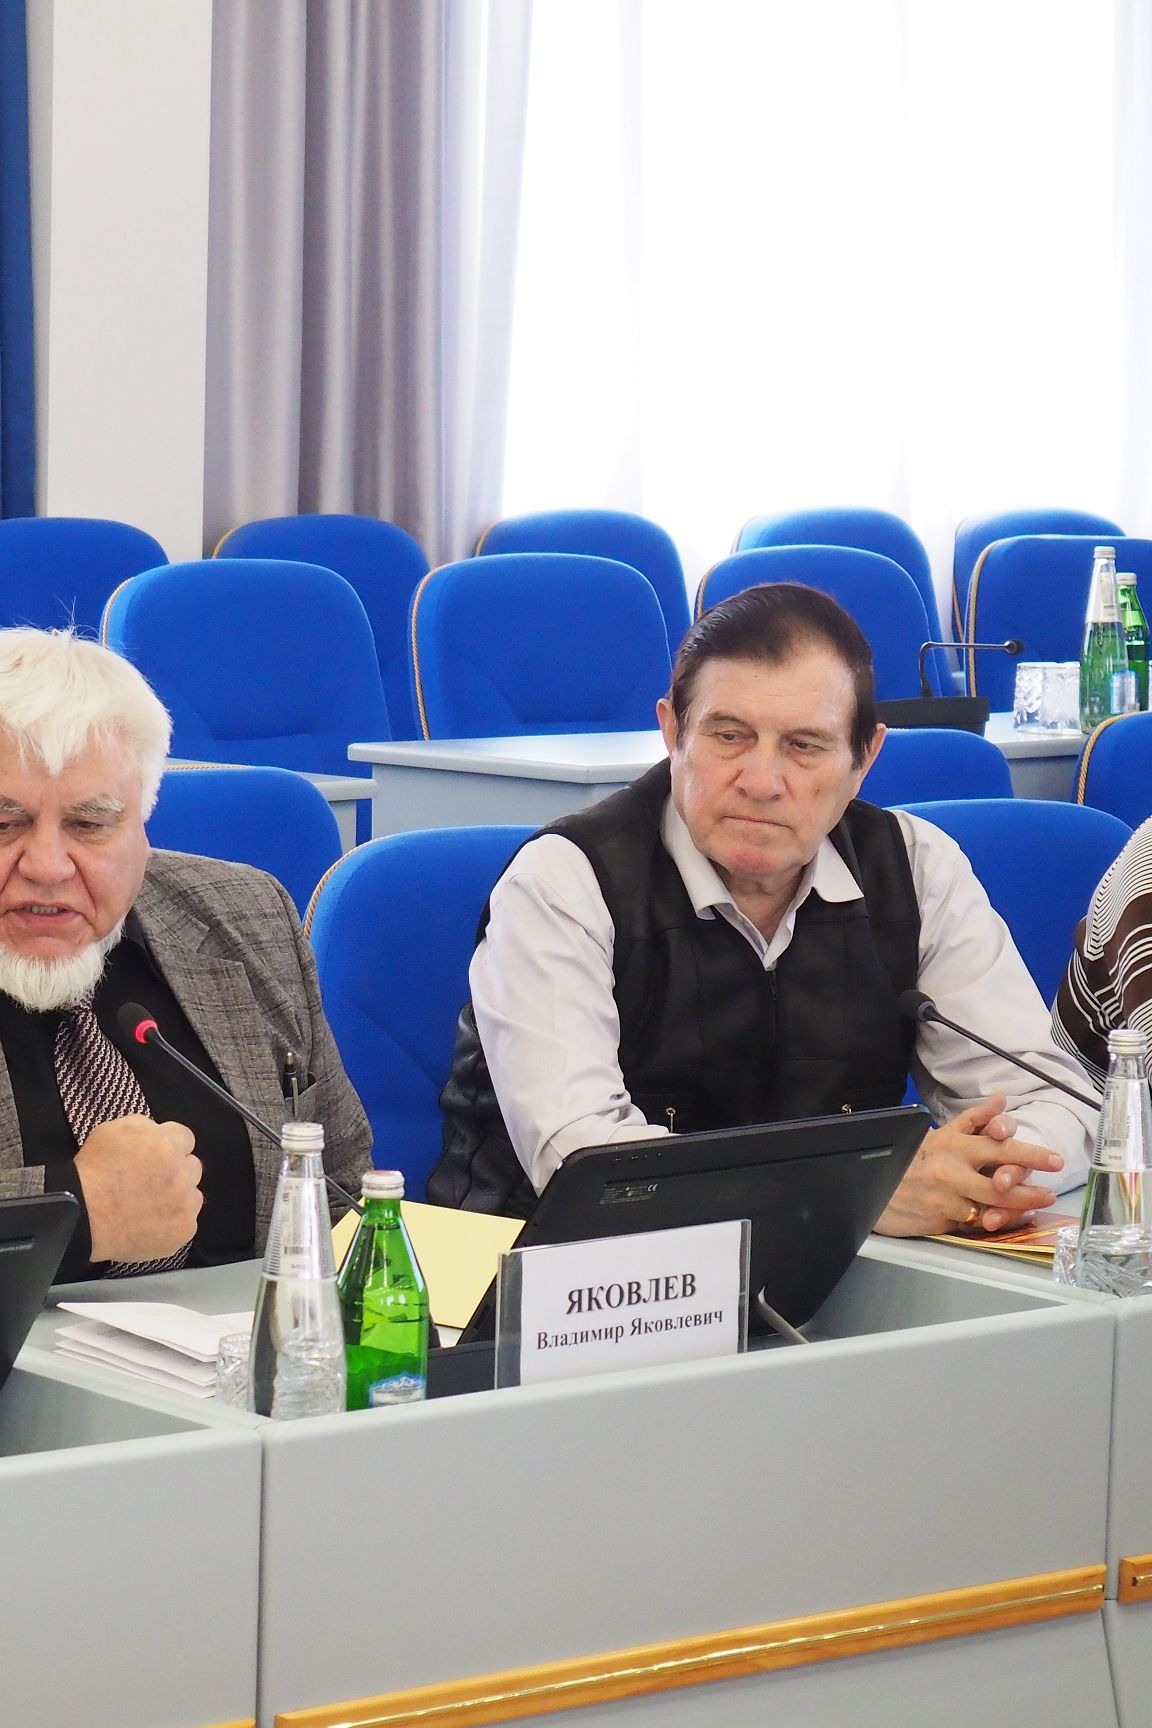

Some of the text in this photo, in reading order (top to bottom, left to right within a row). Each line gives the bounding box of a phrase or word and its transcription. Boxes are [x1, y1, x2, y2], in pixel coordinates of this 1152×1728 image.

[565, 1273, 697, 1315] ЯКОВЛЕВ
[536, 1311, 723, 1350] Владимир Яковлевич
